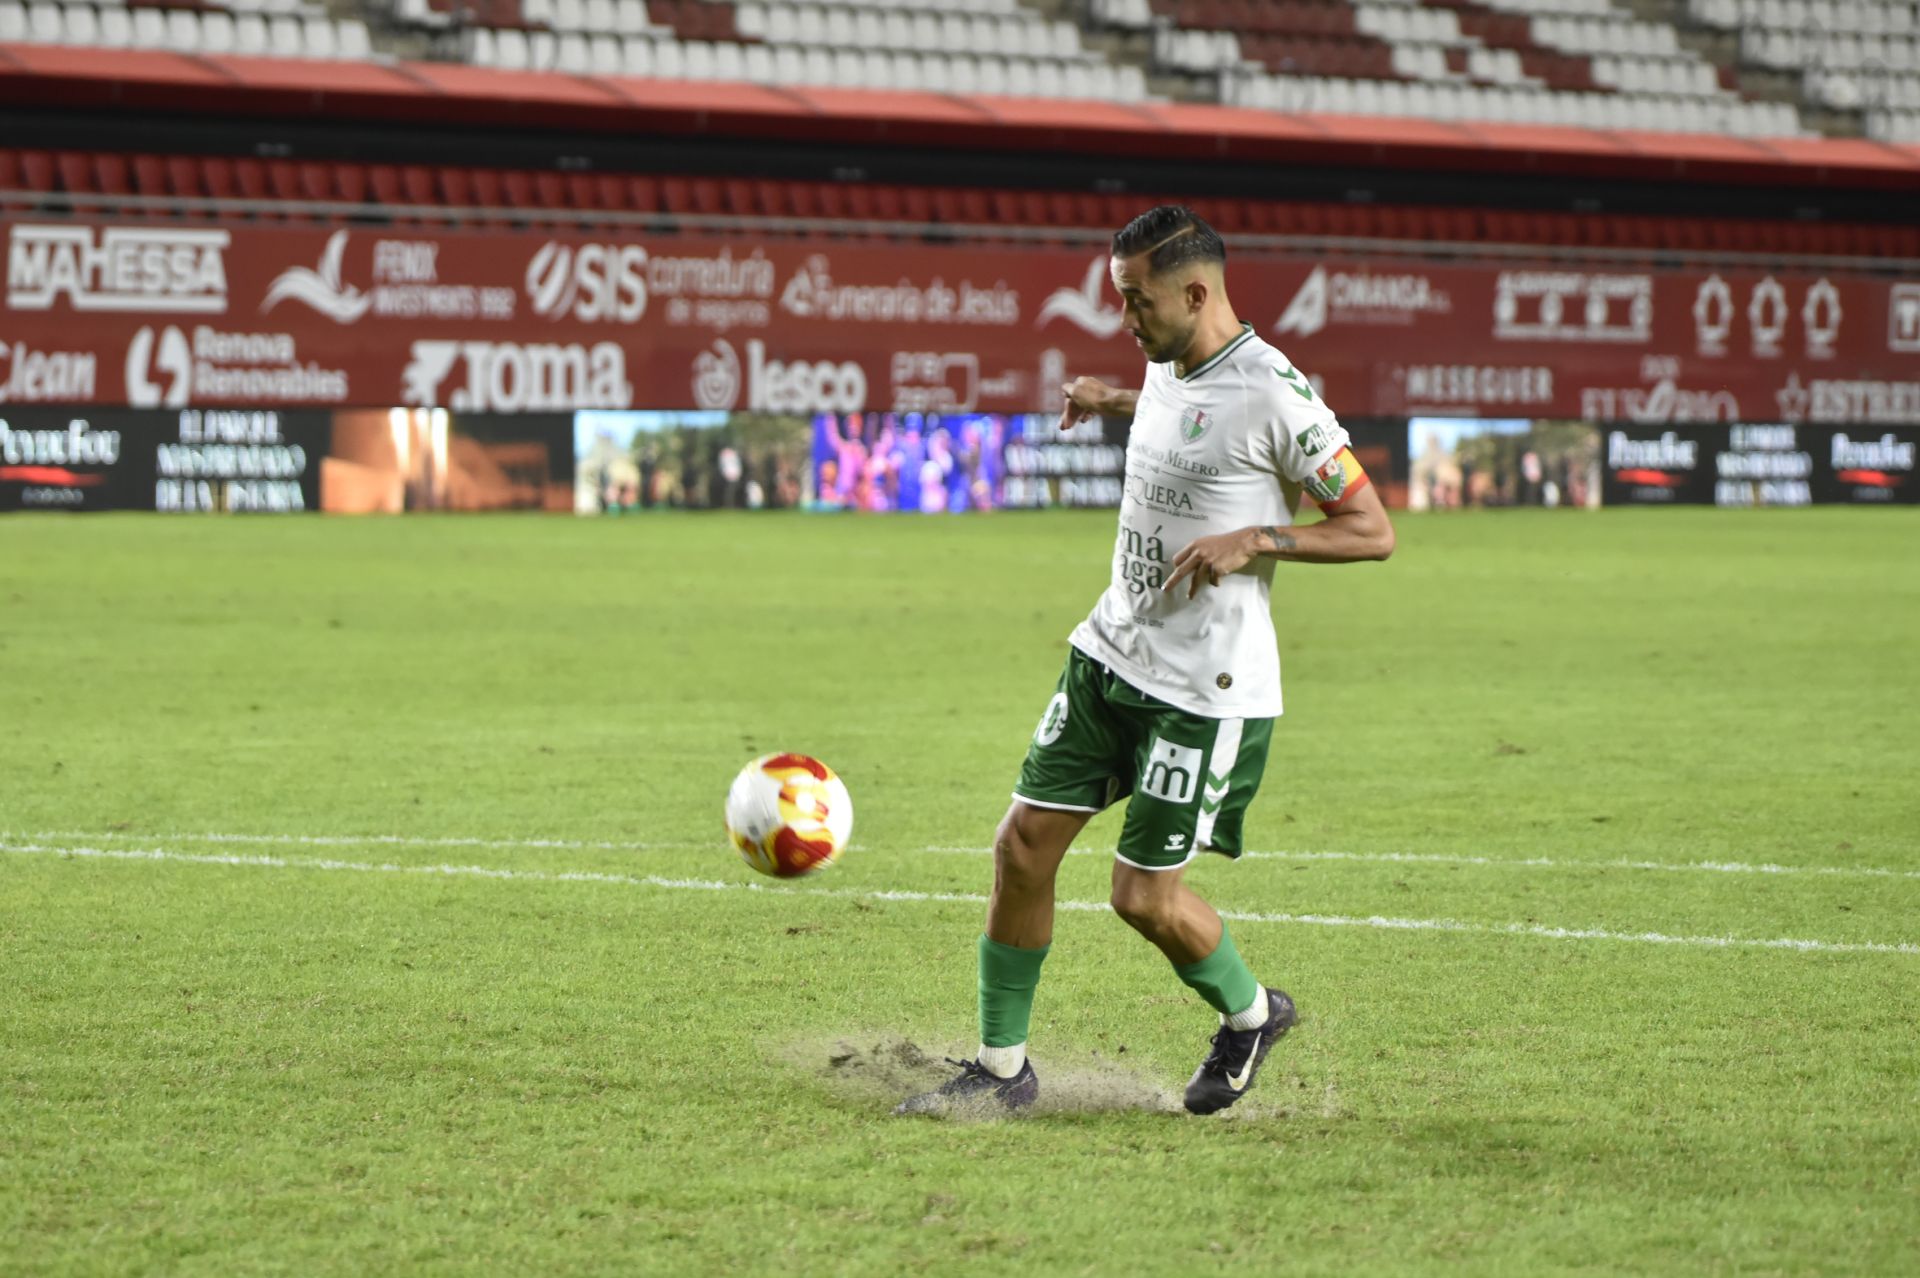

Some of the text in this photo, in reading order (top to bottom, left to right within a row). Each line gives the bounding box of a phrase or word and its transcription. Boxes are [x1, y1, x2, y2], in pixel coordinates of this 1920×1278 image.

[8, 243, 229, 294] MAHESSA
[574, 244, 648, 322] SIS
[1163, 448, 1220, 477] MELERO
